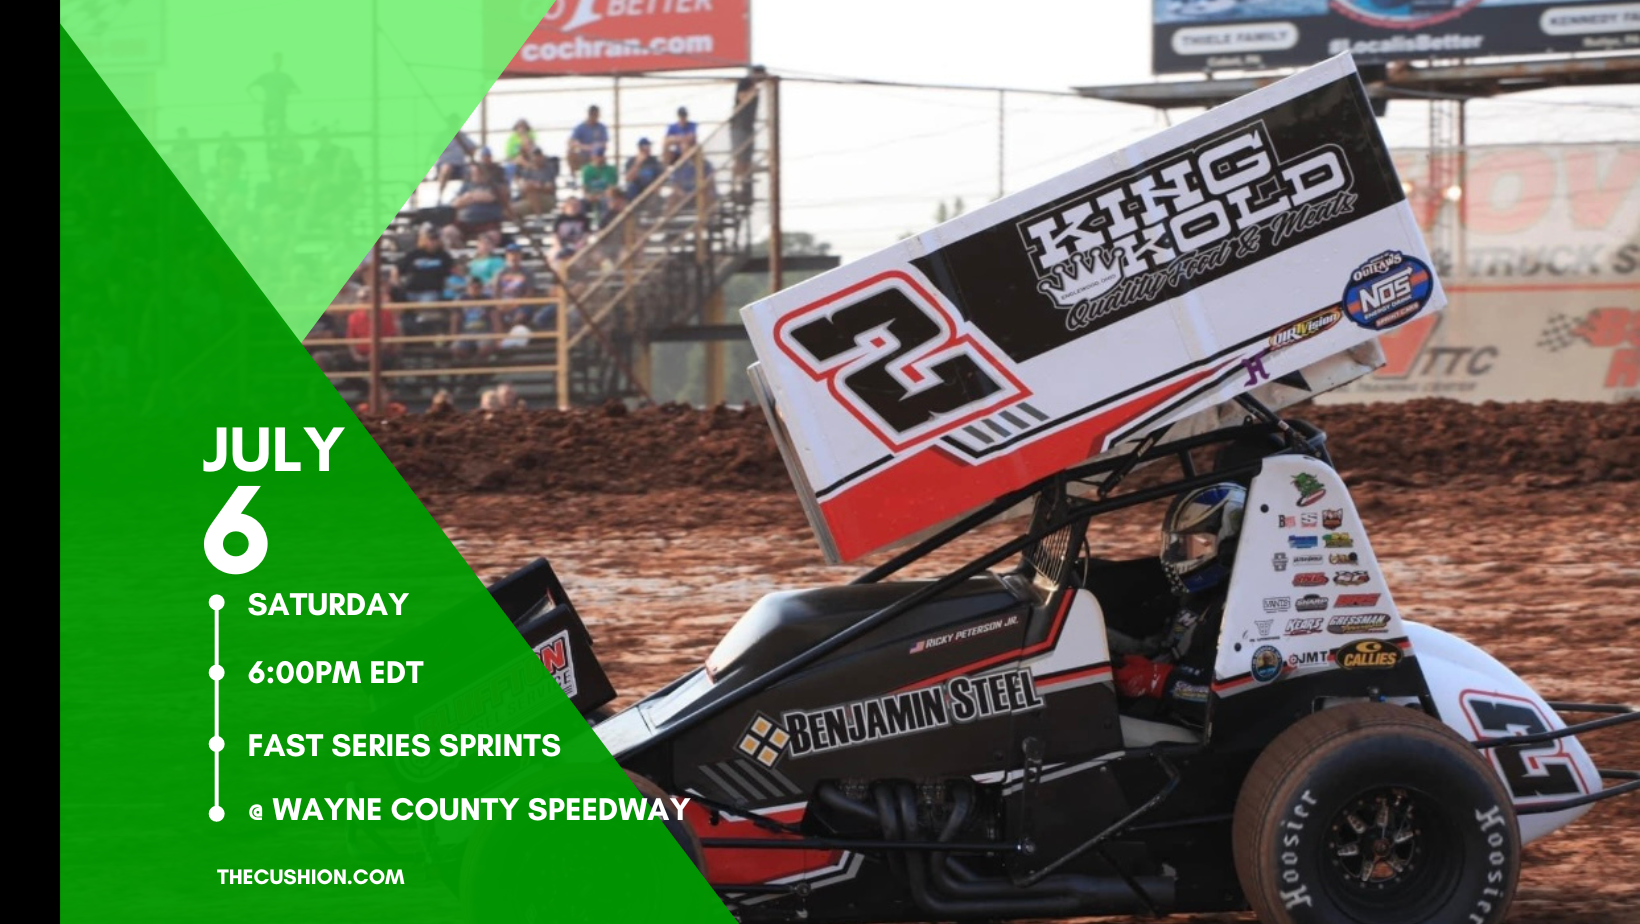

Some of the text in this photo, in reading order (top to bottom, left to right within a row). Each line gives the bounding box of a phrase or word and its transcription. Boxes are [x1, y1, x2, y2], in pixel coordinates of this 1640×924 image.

[521, 34, 714, 61] cochran.com
[1235, 31, 1288, 42] FAMILY
[1027, 130, 1272, 269] KING
[1121, 151, 1345, 277] KOLD
[1065, 192, 1358, 331] Quality Food & Meats
[1359, 267, 1412, 314] NOS
[785, 282, 1010, 440] 2
[925, 615, 1019, 649] RICKY PETERSON JR.
[1343, 652, 1398, 668] CALLIES
[785, 669, 1043, 756] BENJAMIN STEEL
[1464, 695, 1585, 800] 2
[1281, 789, 1318, 910] Hoosier
[1469, 805, 1506, 924] Hoosier
